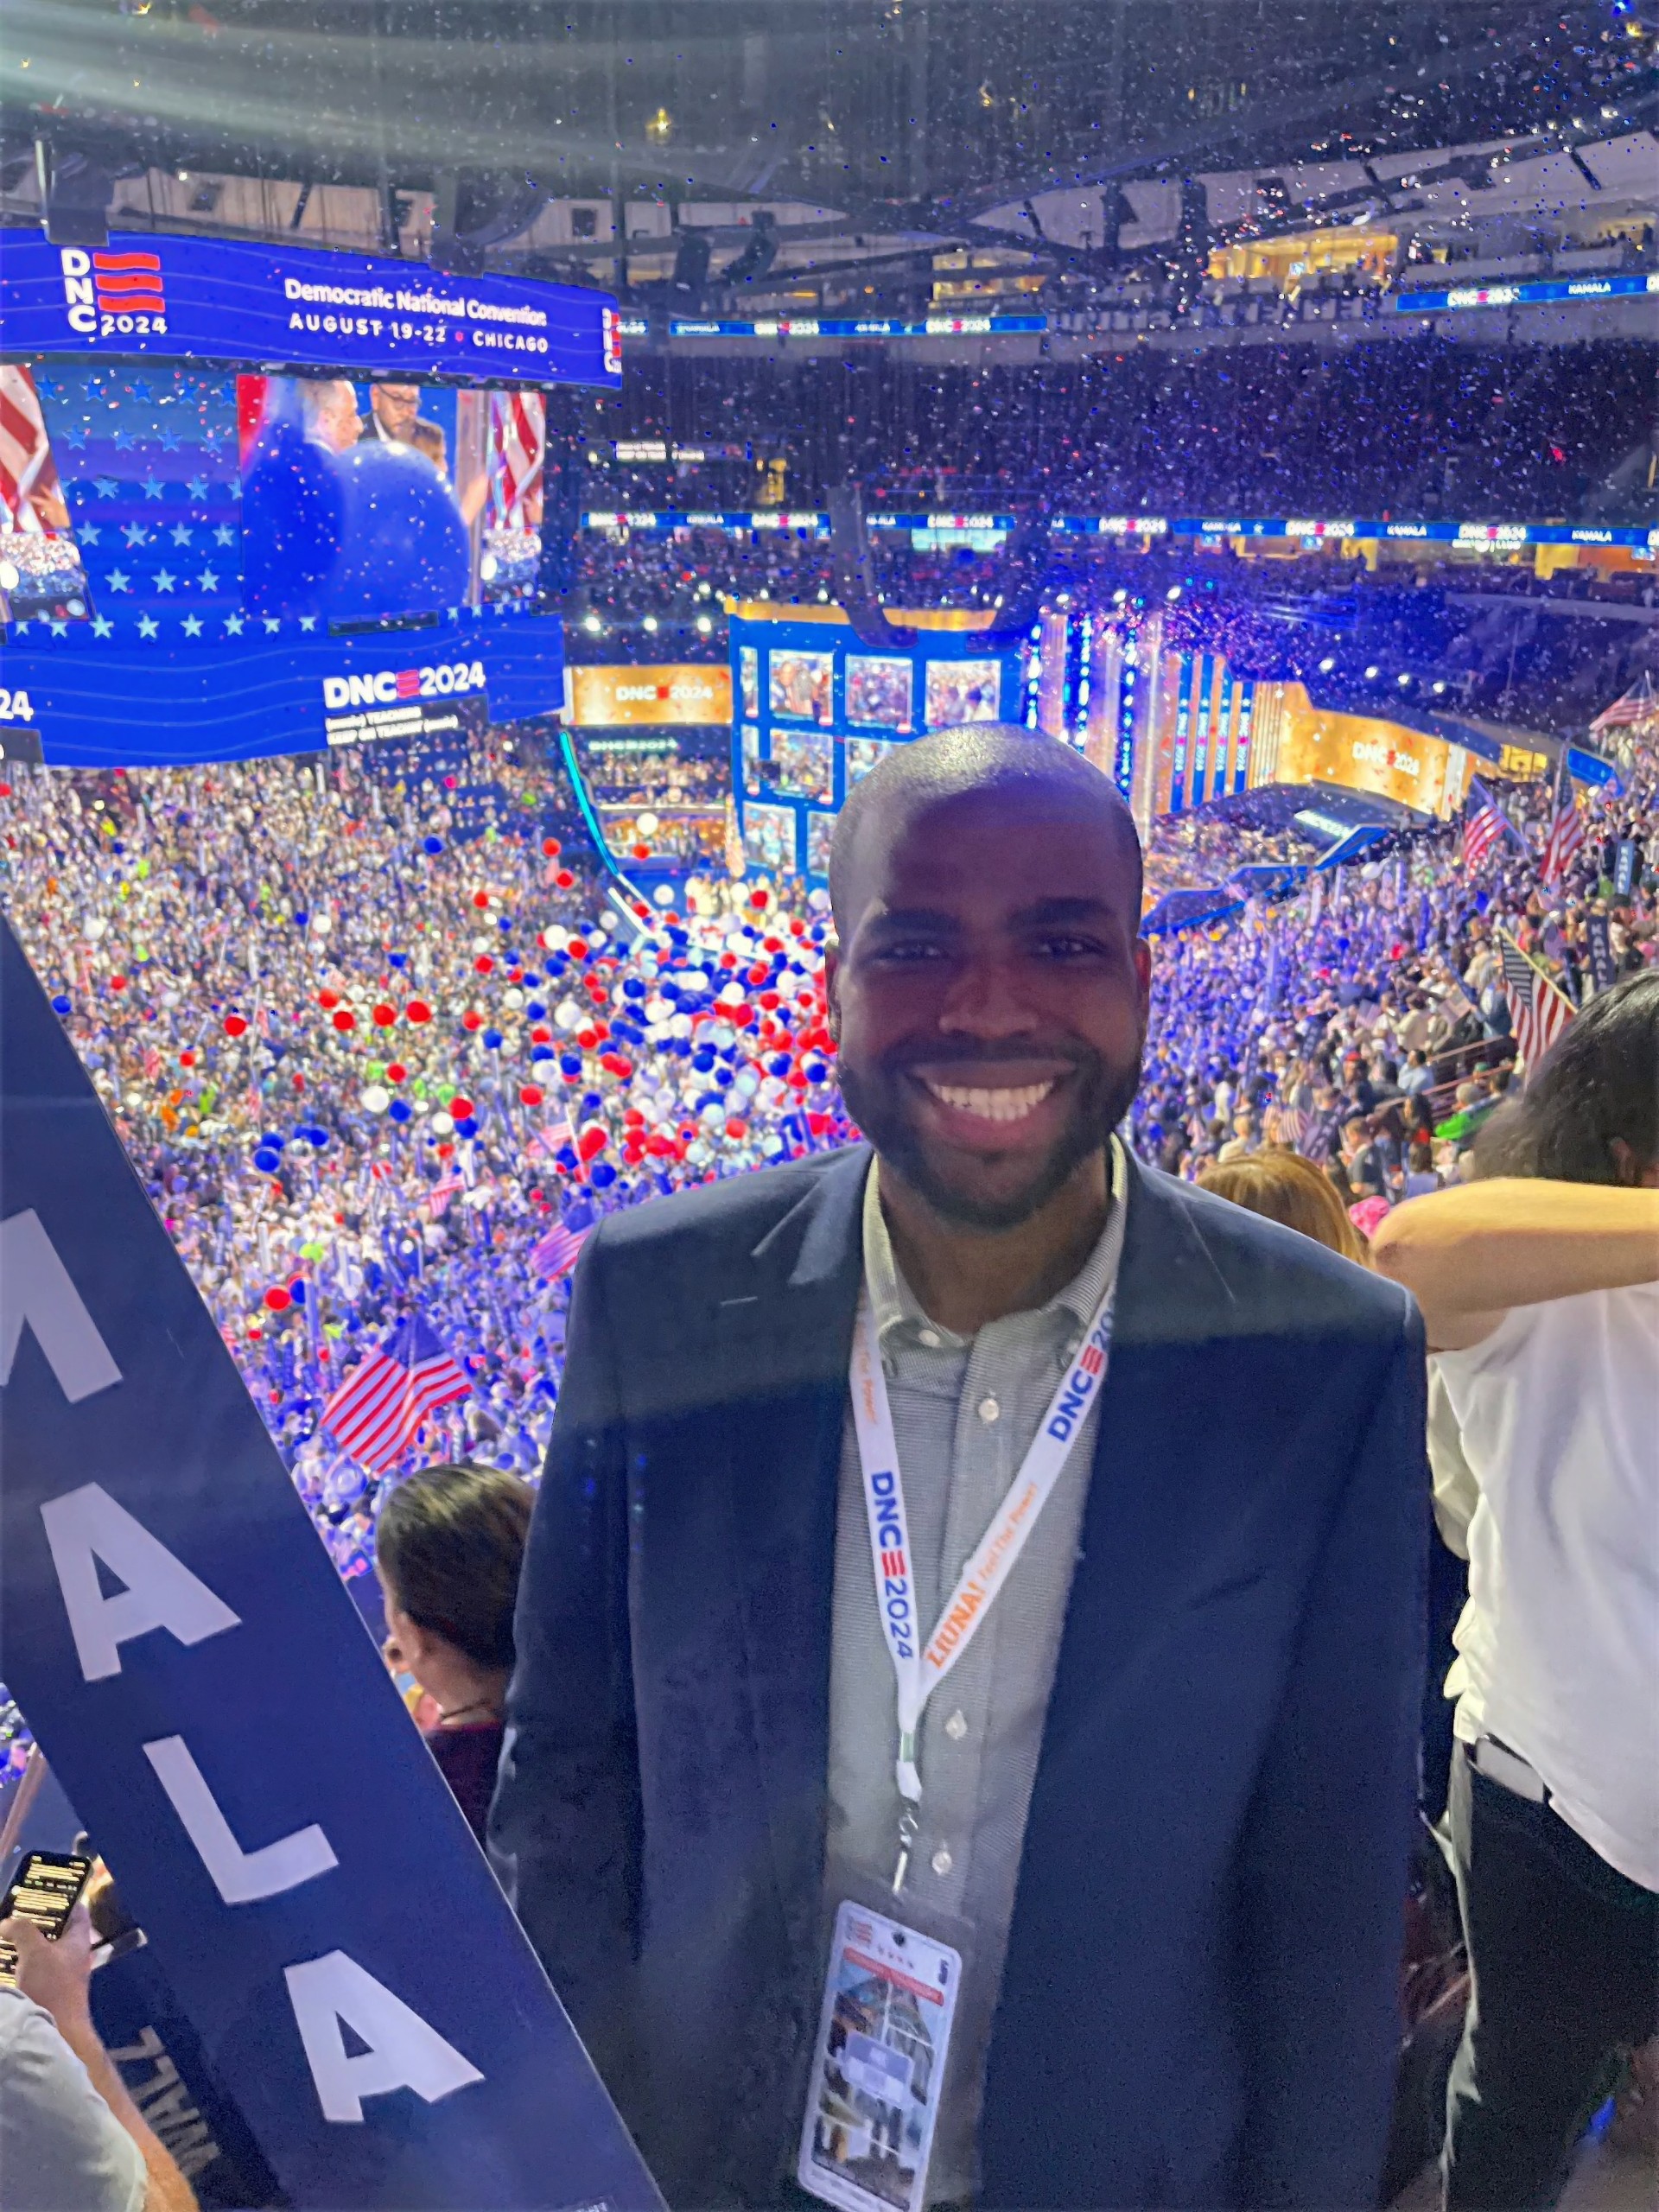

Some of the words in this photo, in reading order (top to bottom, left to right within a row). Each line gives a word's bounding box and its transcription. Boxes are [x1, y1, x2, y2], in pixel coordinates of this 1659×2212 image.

[284, 277, 394, 309] Democratic
[396, 290, 465, 317] National
[467, 300, 547, 327] Convention
[1568, 283, 1611, 295] KAMALA
[100, 315, 168, 336] 2024
[289, 313, 384, 336] AUGUST
[391, 322, 447, 342] 19-22
[473, 330, 548, 353] CHICAGO
[323, 671, 397, 709] DNC
[419, 662, 486, 696] 2024
[616, 685, 657, 701] DNC
[671, 684, 713, 699] 2024
[1351, 741, 1386, 765] DNC
[1047, 1370, 1093, 1442] DNC
[871, 1471, 902, 1548] DNC
[885, 1579, 913, 1659] 2024
